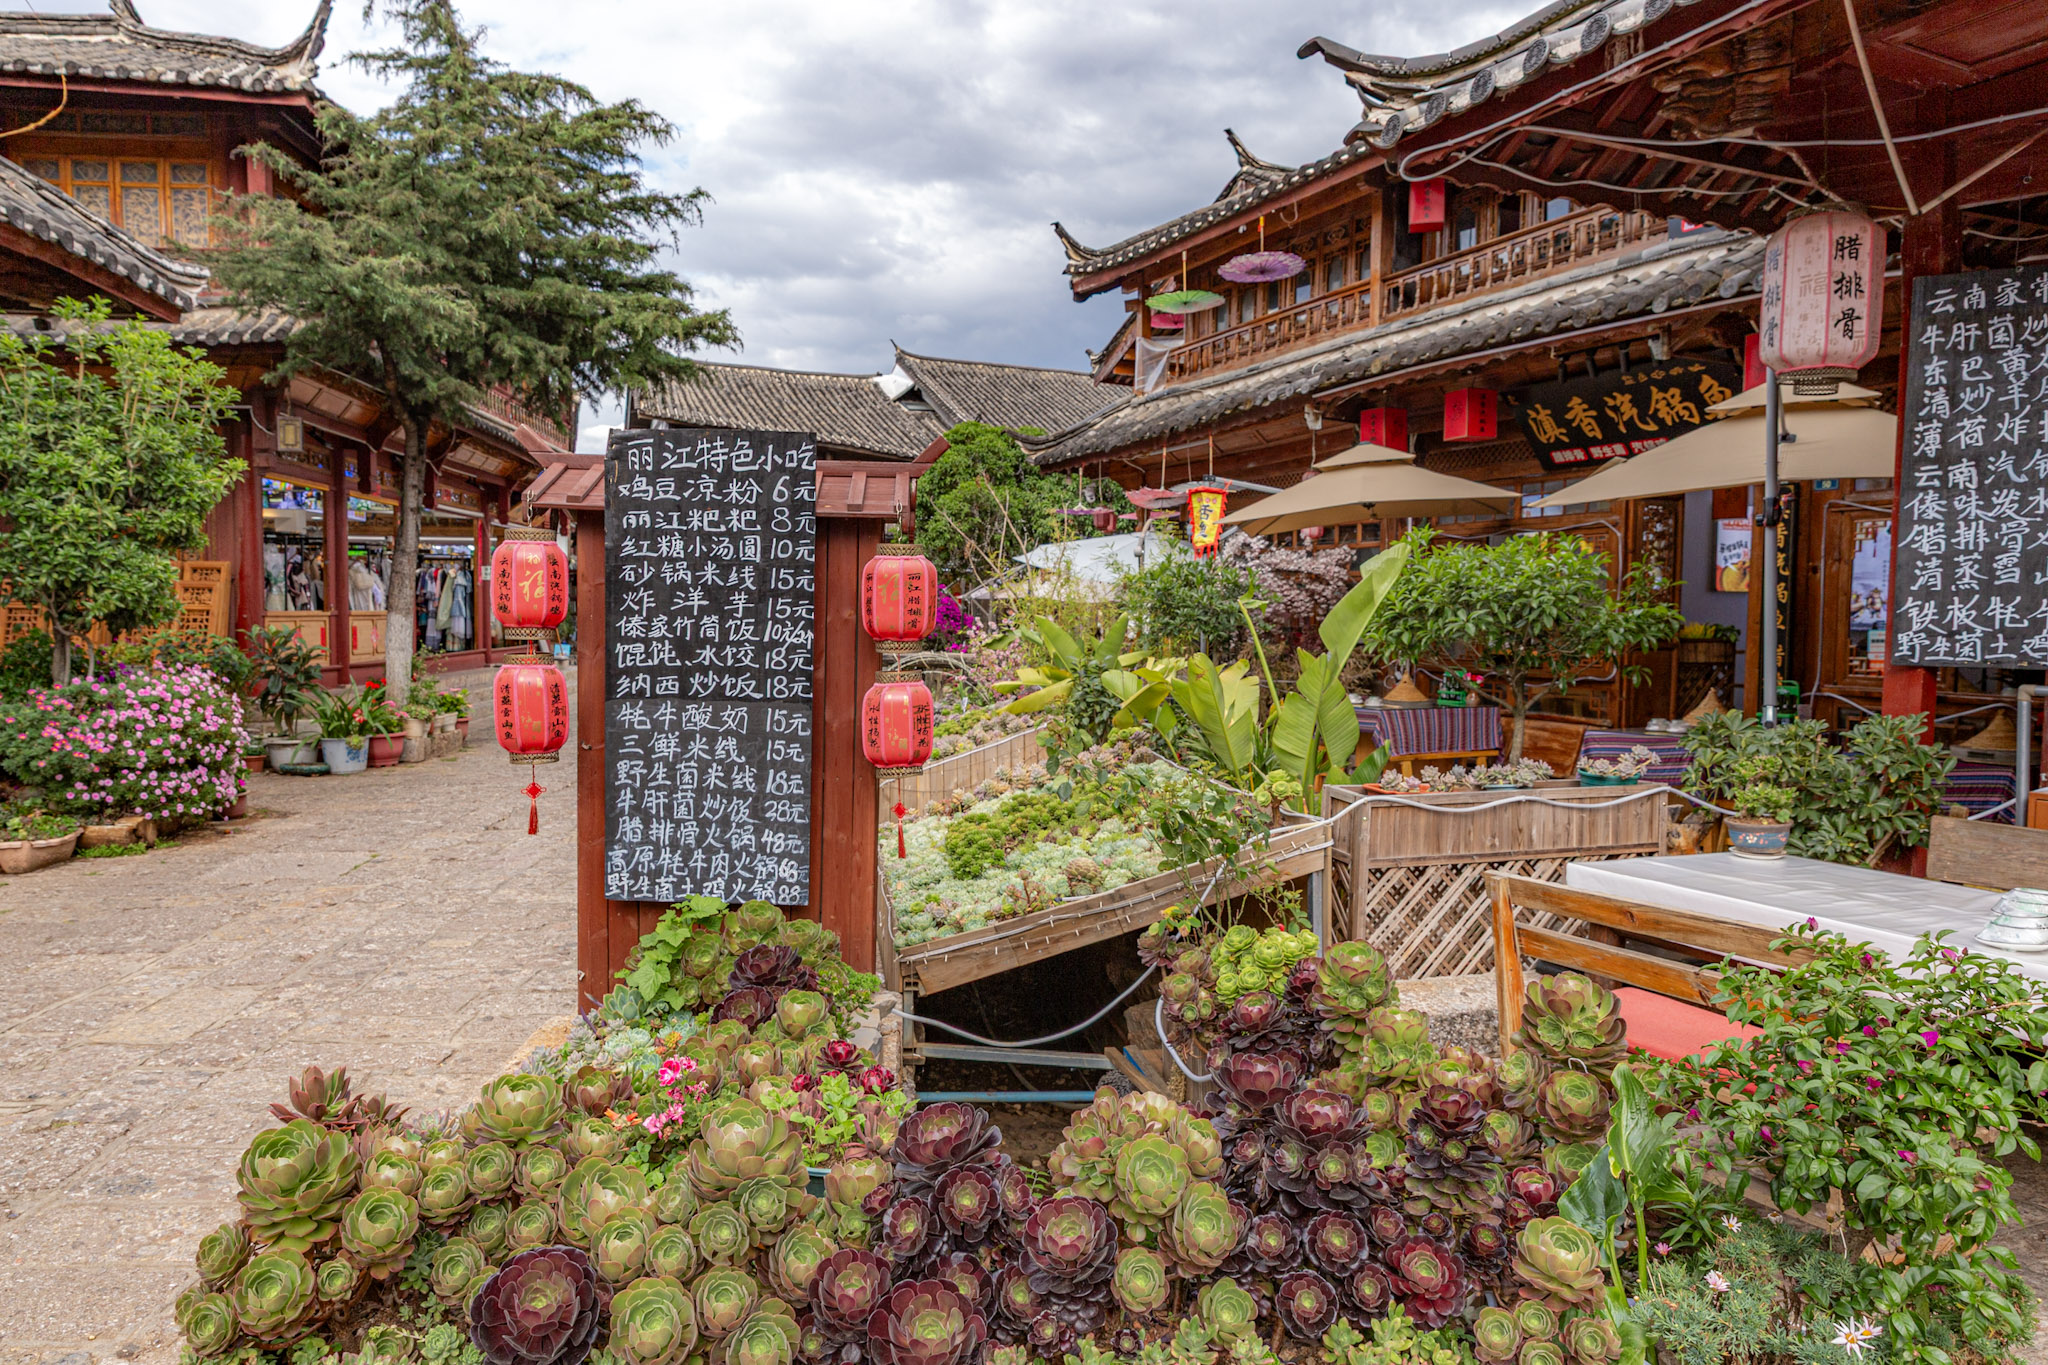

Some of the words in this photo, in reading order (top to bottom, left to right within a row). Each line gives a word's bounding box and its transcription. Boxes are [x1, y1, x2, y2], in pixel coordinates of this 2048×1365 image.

[1834, 234, 1865, 340] 腊排骨
[627, 436, 816, 473] 丽江特色小吃
[618, 474, 763, 505] 鸡豆凉粉
[773, 476, 816, 503] 6元
[623, 508, 761, 532] 丽江粑粑
[771, 507, 816, 534] 8元
[619, 532, 761, 562] 红糖小汤圆
[771, 536, 815, 562] 10元
[619, 561, 757, 590] 砂锅米线
[771, 568, 815, 592] 15元
[619, 586, 754, 618] 炸洋芋
[767, 598, 814, 619] 15元
[616, 615, 760, 642] 傣家竹筒饭
[765, 648, 813, 672] 18元
[616, 670, 763, 699] 纳西炒饭
[767, 676, 813, 698] 18元
[616, 700, 748, 734] 牦牛酸奶
[766, 708, 811, 736] 15元
[619, 731, 745, 762] 三鲜米线
[766, 740, 805, 762] 15元
[615, 760, 757, 793] 野生菌米线
[766, 769, 804, 795] 18元
[615, 787, 762, 823] 牛肝菌炒饭
[764, 800, 808, 823] 28元
[615, 816, 756, 853] 腊排骨火锅
[761, 829, 804, 854] 48元
[607, 845, 778, 882] 高原牦牛肉火锅
